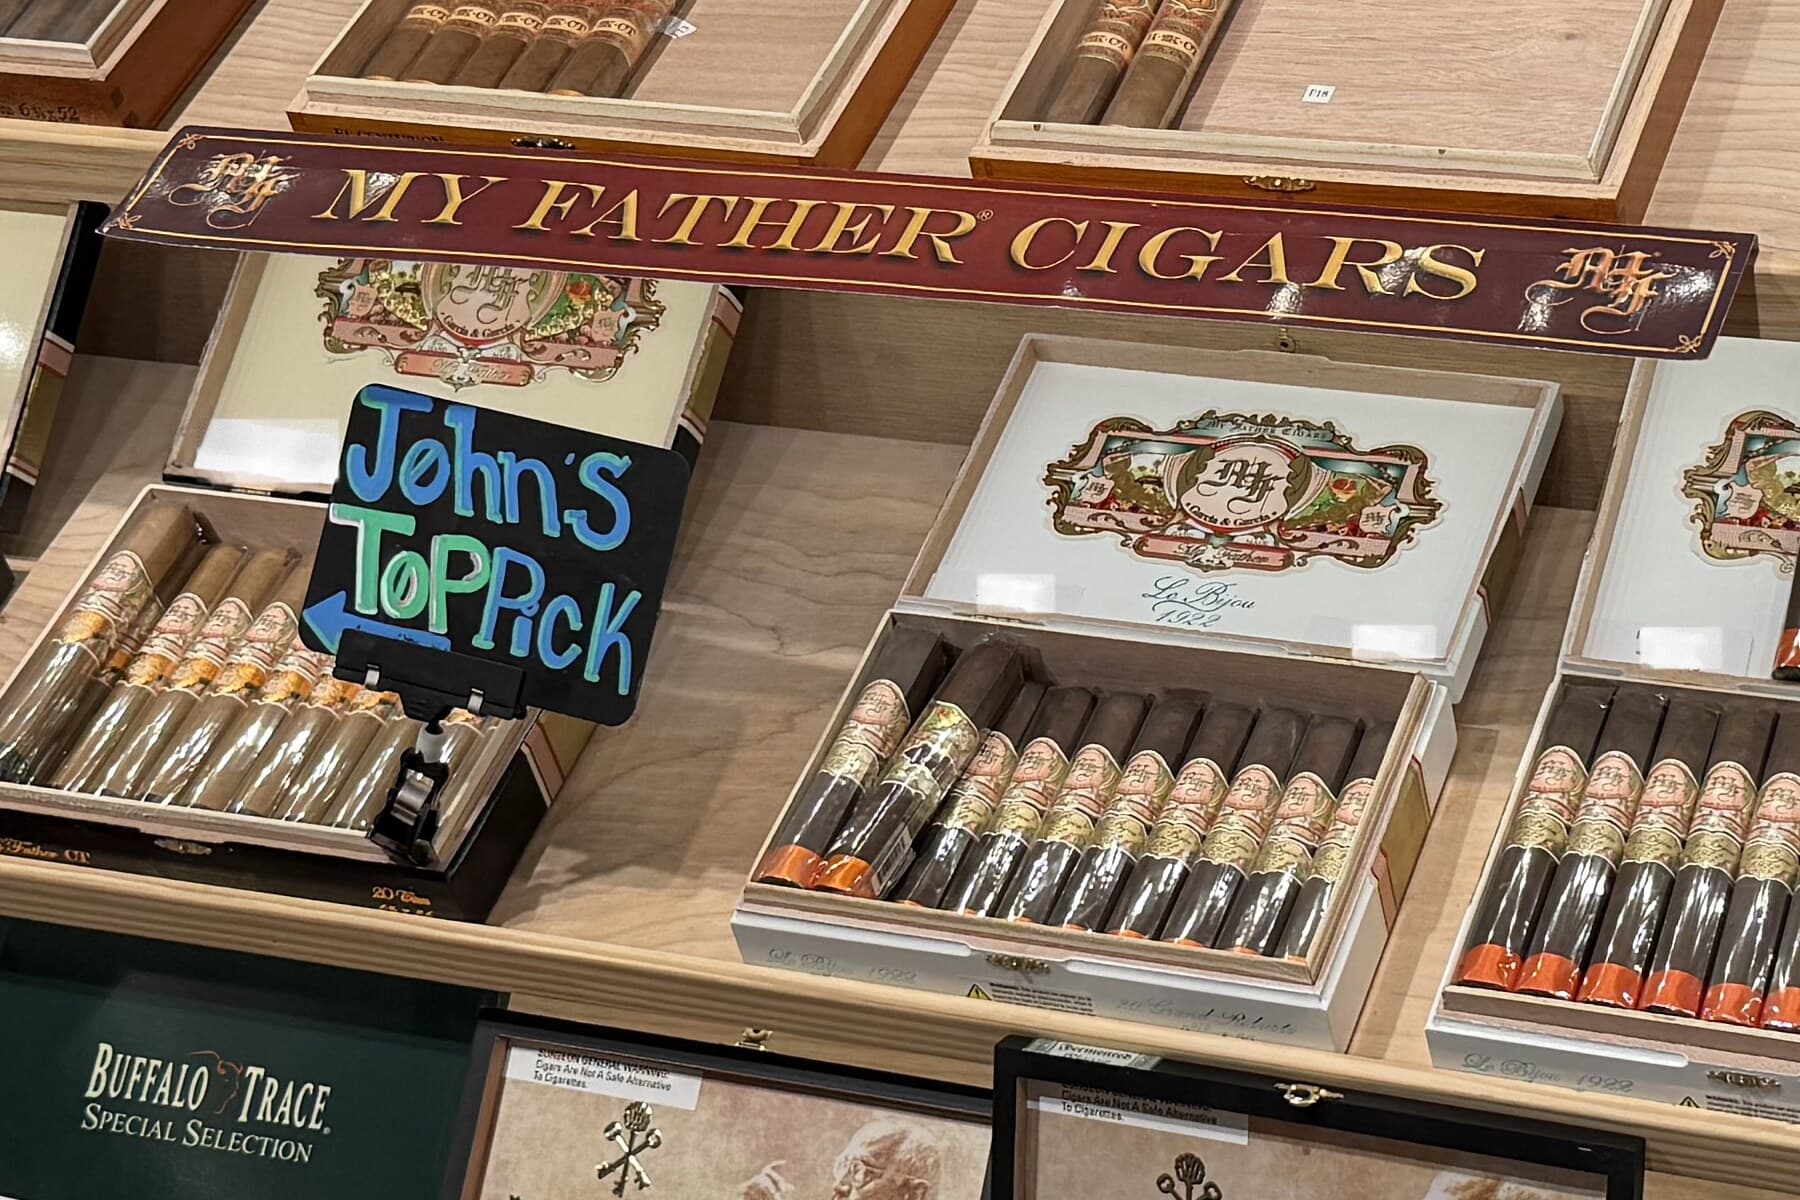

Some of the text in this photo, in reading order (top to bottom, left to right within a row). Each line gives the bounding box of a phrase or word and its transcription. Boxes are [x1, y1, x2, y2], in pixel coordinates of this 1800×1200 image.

[311, 168, 508, 227] MY
[1008, 216, 1487, 303] CIGARS
[1155, 609, 1222, 628] 1922
[83, 1041, 210, 1112] BUFFALO
[533, 1070, 543, 1081] To
[563, 1062, 579, 1075] Are
[580, 1066, 596, 1078] Not
[1062, 1101, 1073, 1112] To
[80, 1102, 314, 1164] SPECIAL SELECTION
